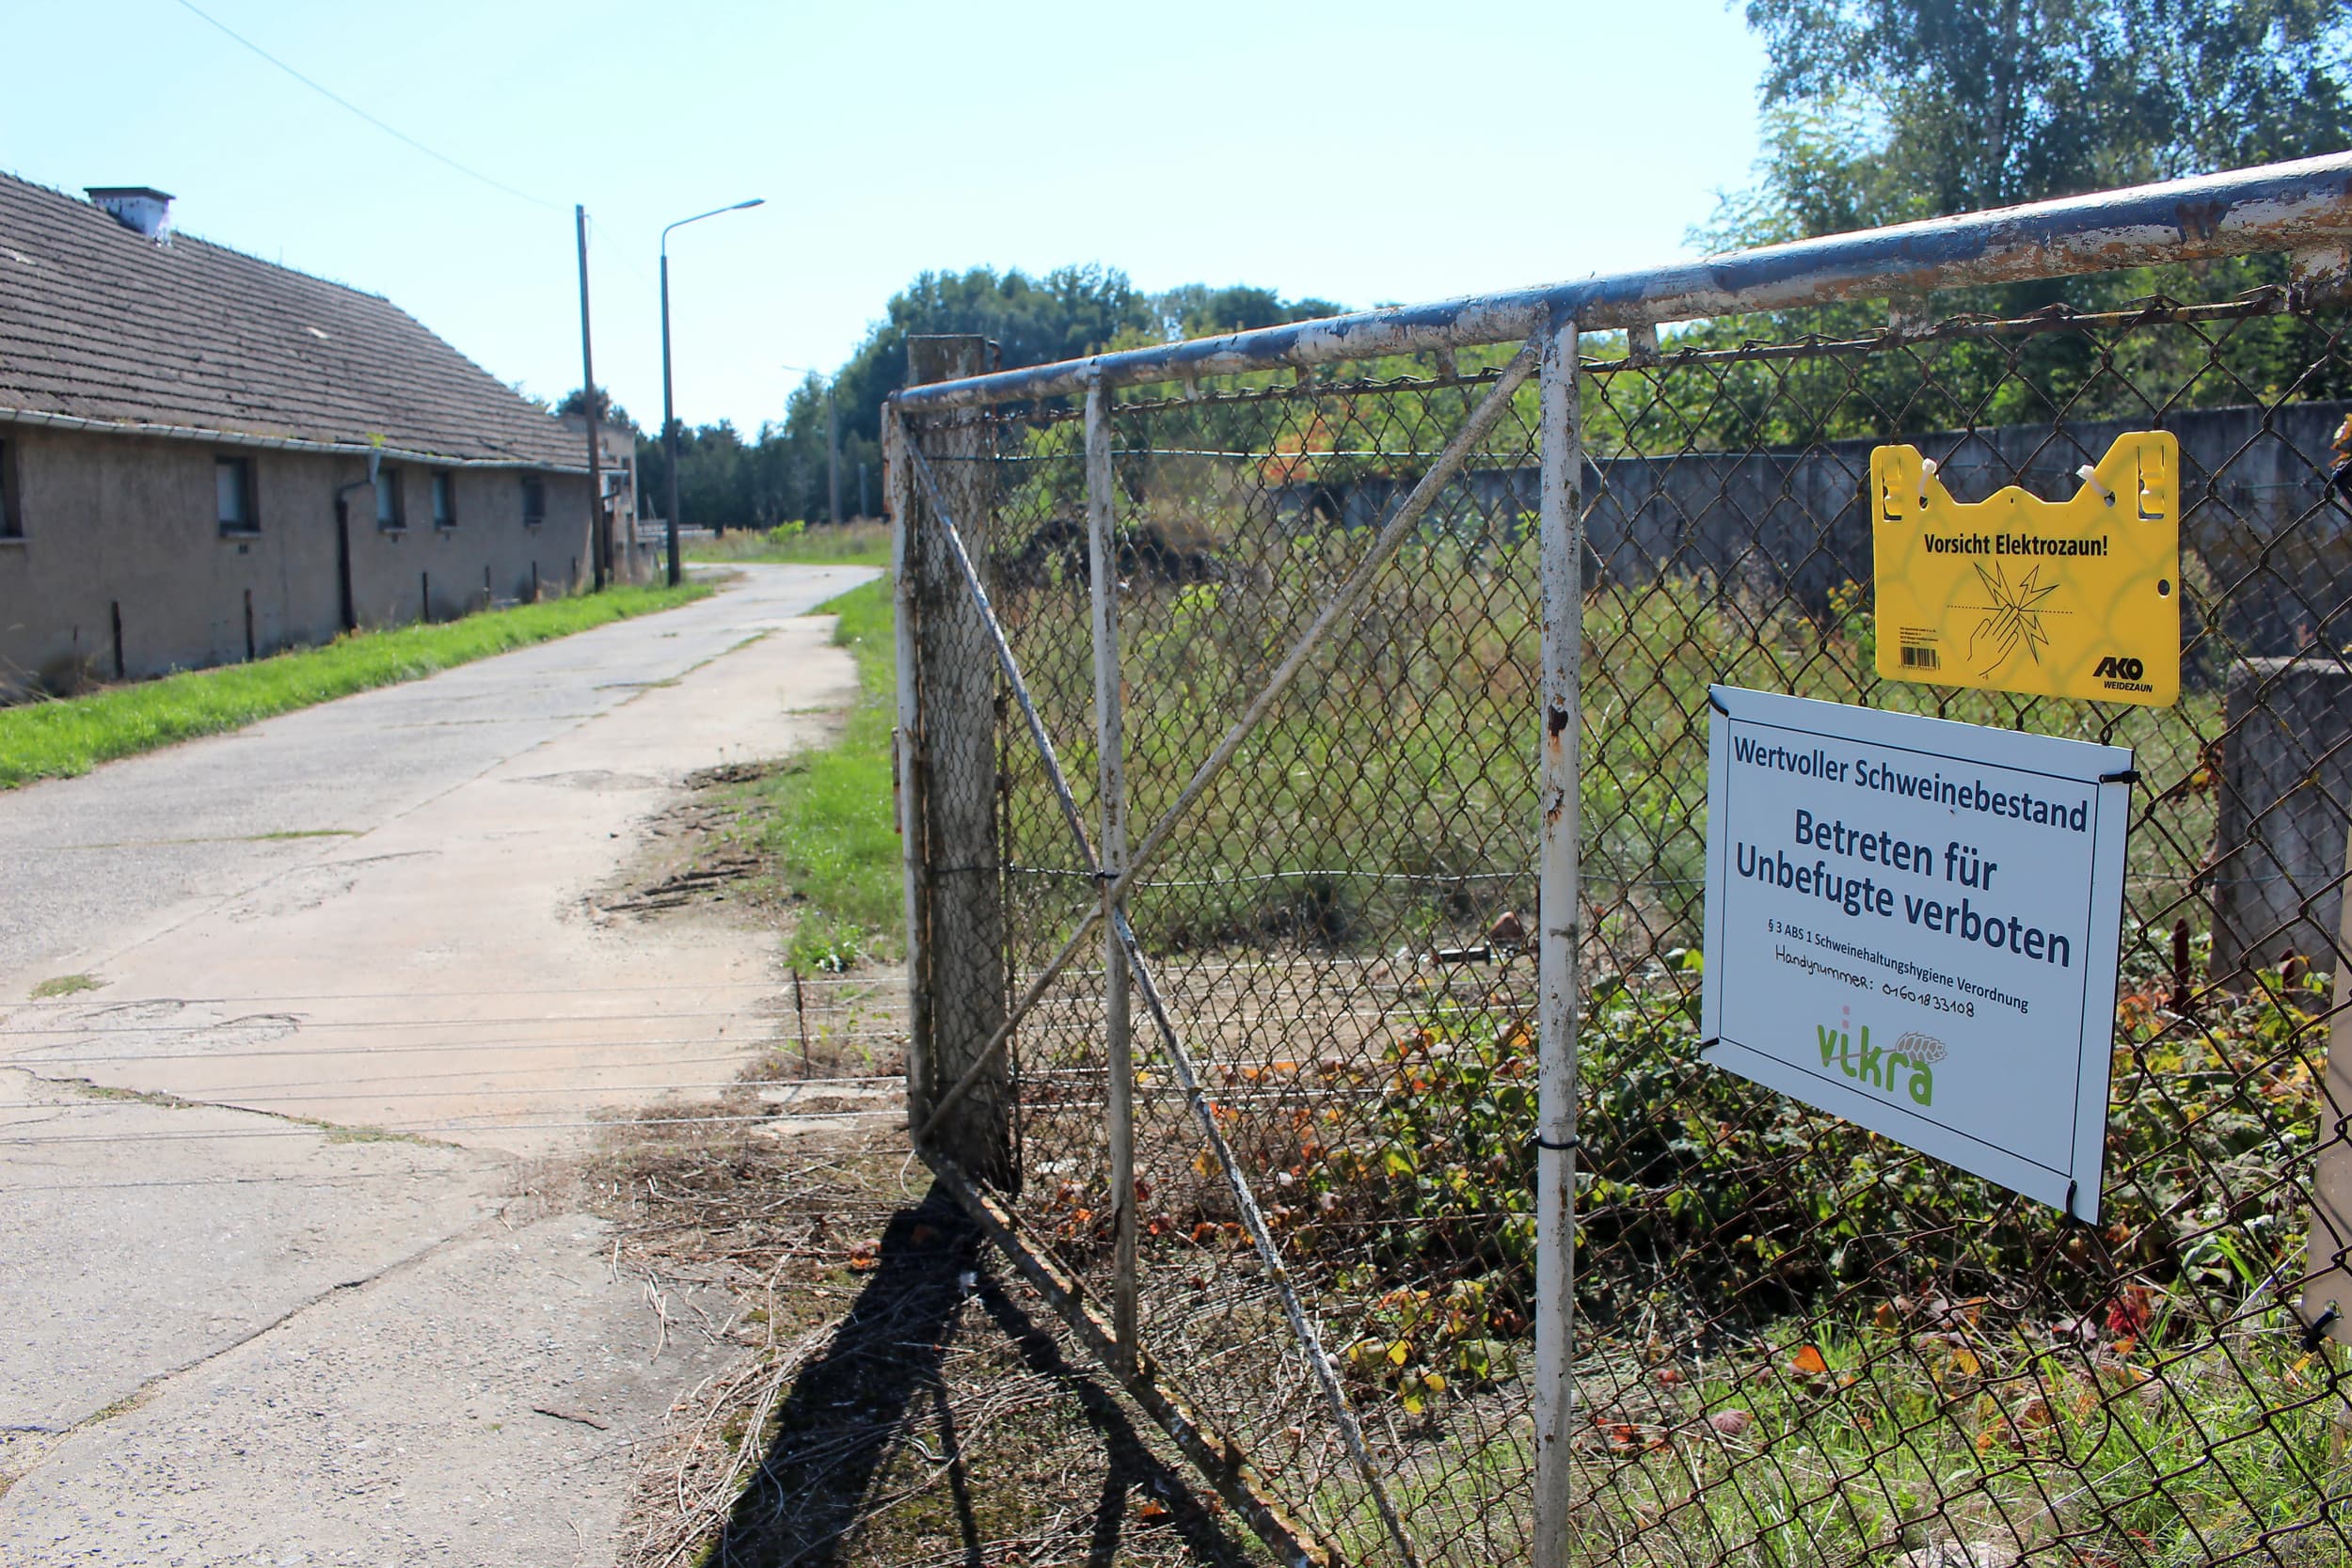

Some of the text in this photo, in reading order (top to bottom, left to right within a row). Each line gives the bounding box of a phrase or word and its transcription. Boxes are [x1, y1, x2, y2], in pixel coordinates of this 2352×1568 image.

[1924, 533, 2108, 557] Vorsicht Elektrozaun!
[2092, 657, 2143, 681] AKO
[2104, 681, 2153, 692] WEIDEZAUN
[1734, 736, 2089, 833] Wertvoller Schweinebestand
[1795, 809, 1997, 892] Betreten für
[1737, 842, 2071, 968] Unbefugte verboten
[1768, 918, 2029, 1014] § 3 ABS 1 Schweinehaltungshygiene Verordnung
